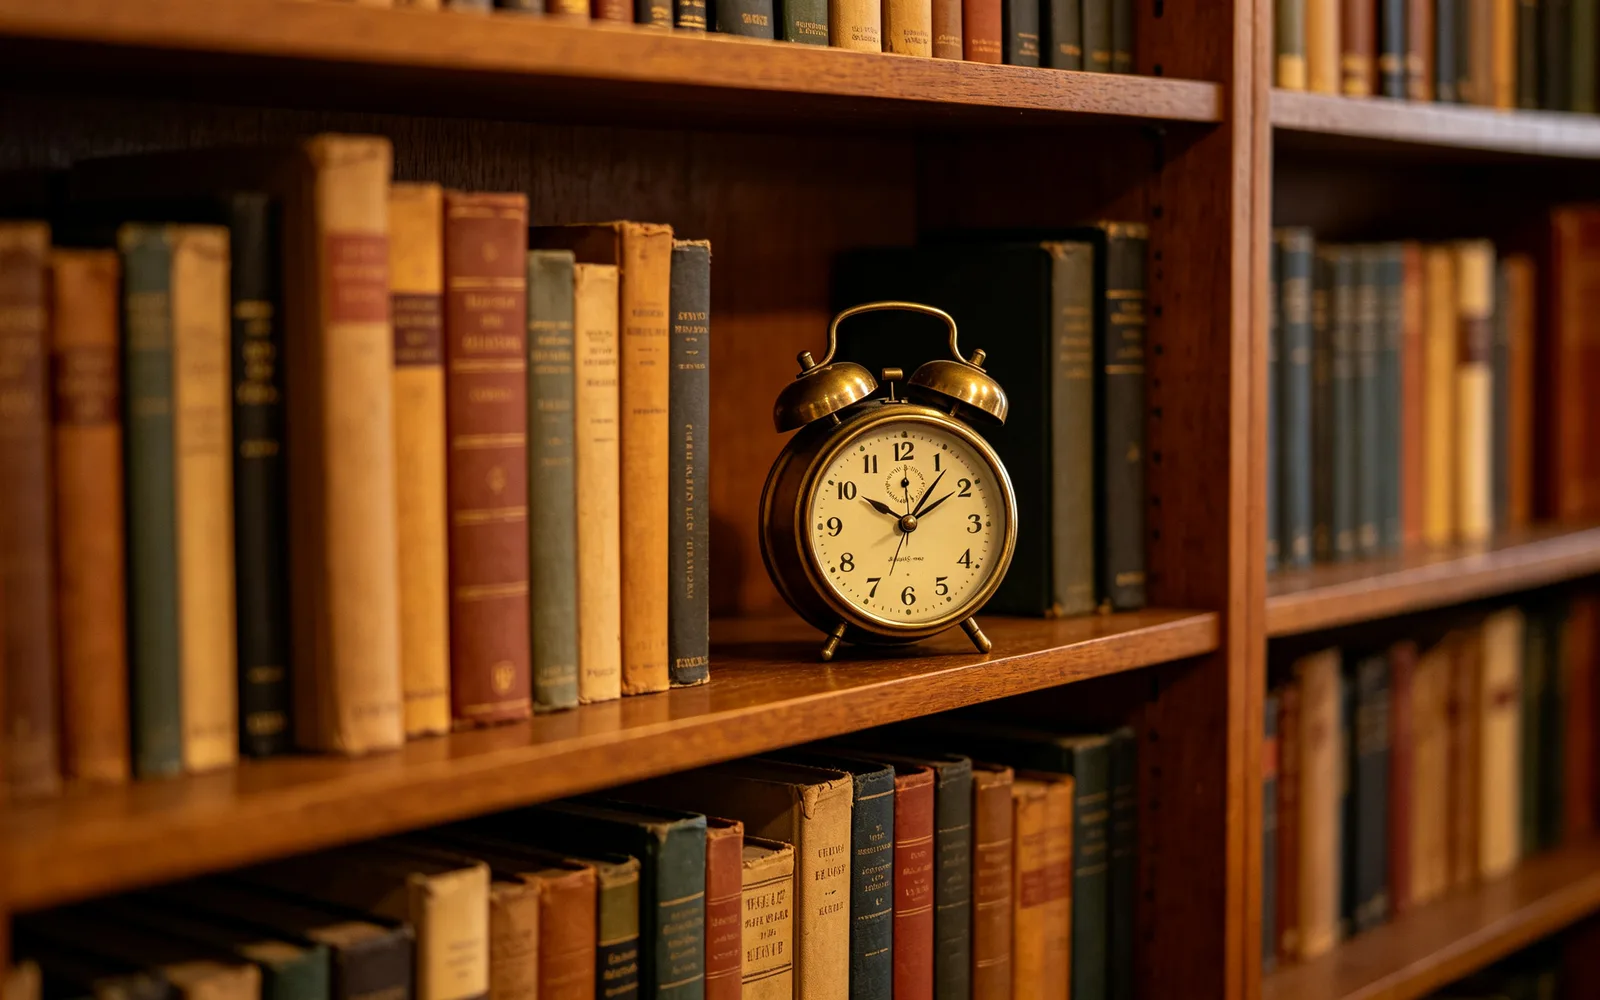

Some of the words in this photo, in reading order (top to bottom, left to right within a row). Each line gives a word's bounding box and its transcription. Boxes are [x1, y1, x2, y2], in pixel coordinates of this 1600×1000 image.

[893, 442, 914, 461] 12
[864, 455, 878, 473] 11
[934, 453, 941, 471] 1
[838, 481, 857, 500] 10
[957, 479, 972, 497] 2
[826, 517, 842, 536] 9
[967, 514, 982, 533] 3
[839, 553, 855, 572] 8
[956, 548, 973, 568] 4
[866, 578, 881, 598] 7
[901, 586, 916, 606] 6
[935, 577, 949, 596] 5
